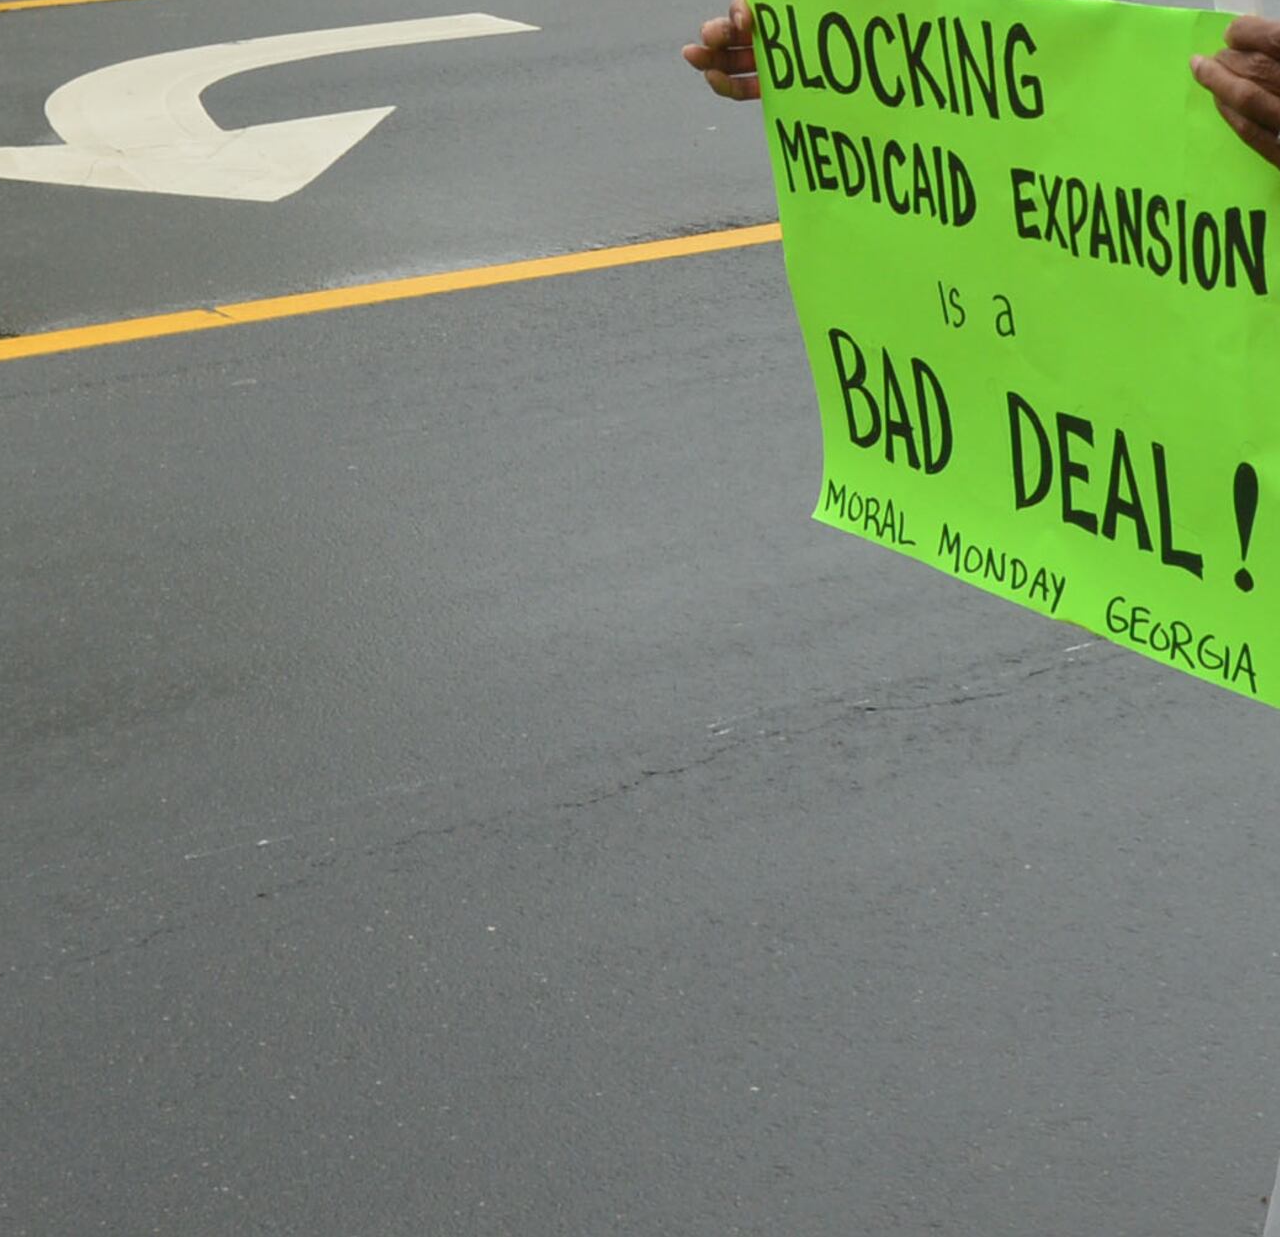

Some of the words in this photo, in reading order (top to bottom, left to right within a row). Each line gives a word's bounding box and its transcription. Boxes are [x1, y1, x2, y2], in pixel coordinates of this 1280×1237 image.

[753, 2, 1045, 120] BLOCKING
[774, 117, 978, 228] MEDICAID
[1009, 167, 1269, 297] EXPANSION
[992, 294, 1016, 338] a
[827, 327, 954, 476] BAD
[823, 478, 917, 549] MORAL
[936, 521, 1067, 614] MONDAY
[1103, 594, 1258, 694] GEORGIA
